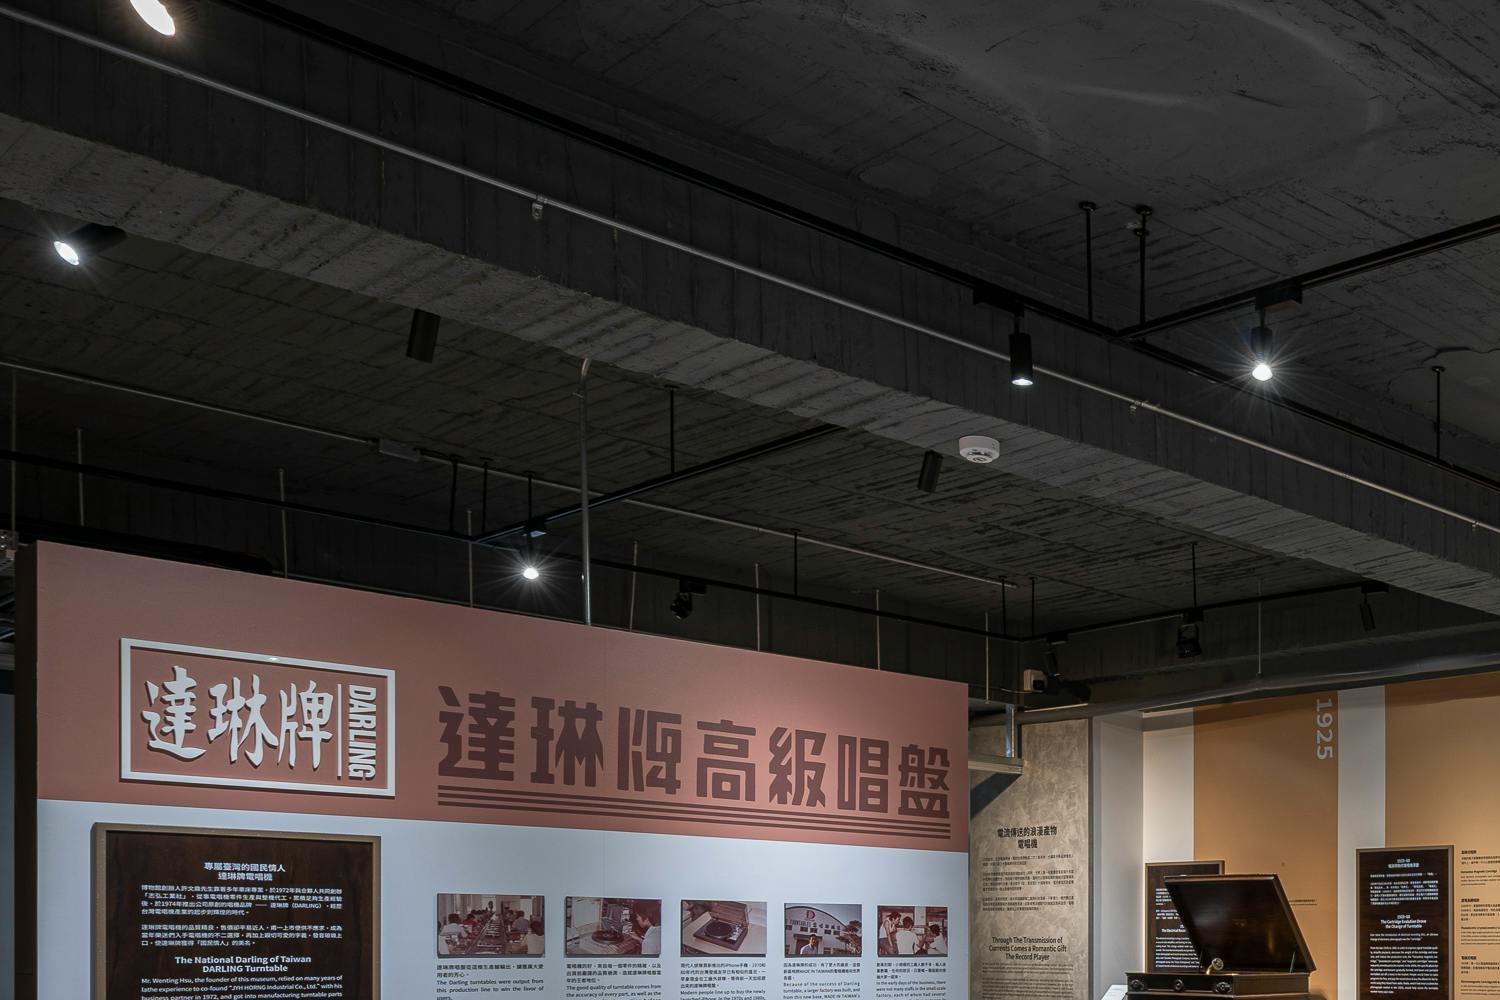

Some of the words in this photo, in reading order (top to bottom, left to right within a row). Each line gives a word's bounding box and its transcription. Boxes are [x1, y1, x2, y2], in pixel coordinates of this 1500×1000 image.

[142, 665, 333, 769] 達琳牌
[348, 684, 377, 779] DARLING
[1316, 698, 1333, 760] 1925
[438, 685, 950, 819] 達琳牌高級唱盤
[992, 937, 1013, 945] Through
[1033, 954, 1050, 962] Player
[175, 956, 193, 964] The
[194, 956, 234, 964] National
[235, 956, 268, 966] Darling
[281, 955, 312, 963] Taiwan
[202, 965, 243, 973] DARLING
[245, 964, 288, 973] Turntable
